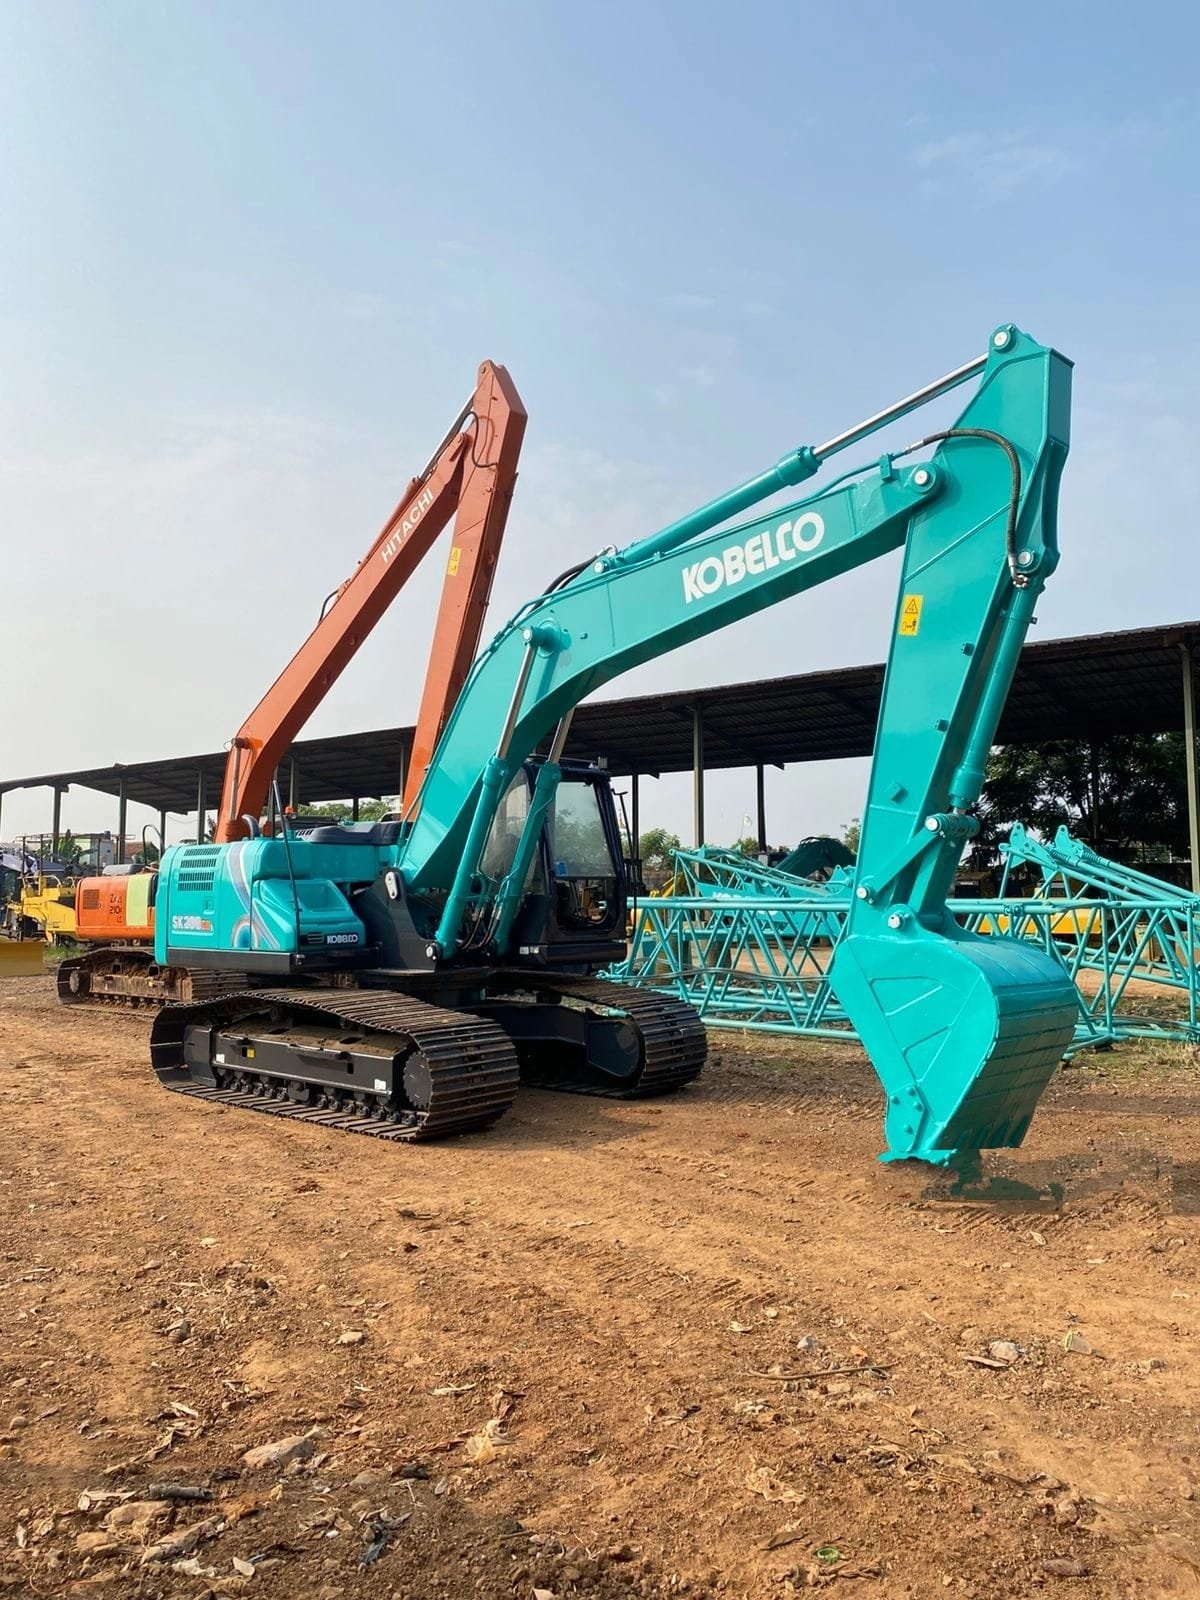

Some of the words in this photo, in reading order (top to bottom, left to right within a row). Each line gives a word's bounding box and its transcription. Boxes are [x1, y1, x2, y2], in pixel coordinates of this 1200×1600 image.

[381, 488, 434, 563] HITACHI
[682, 512, 824, 604] KOBELCO
[326, 934, 359, 945] KOBELCO
